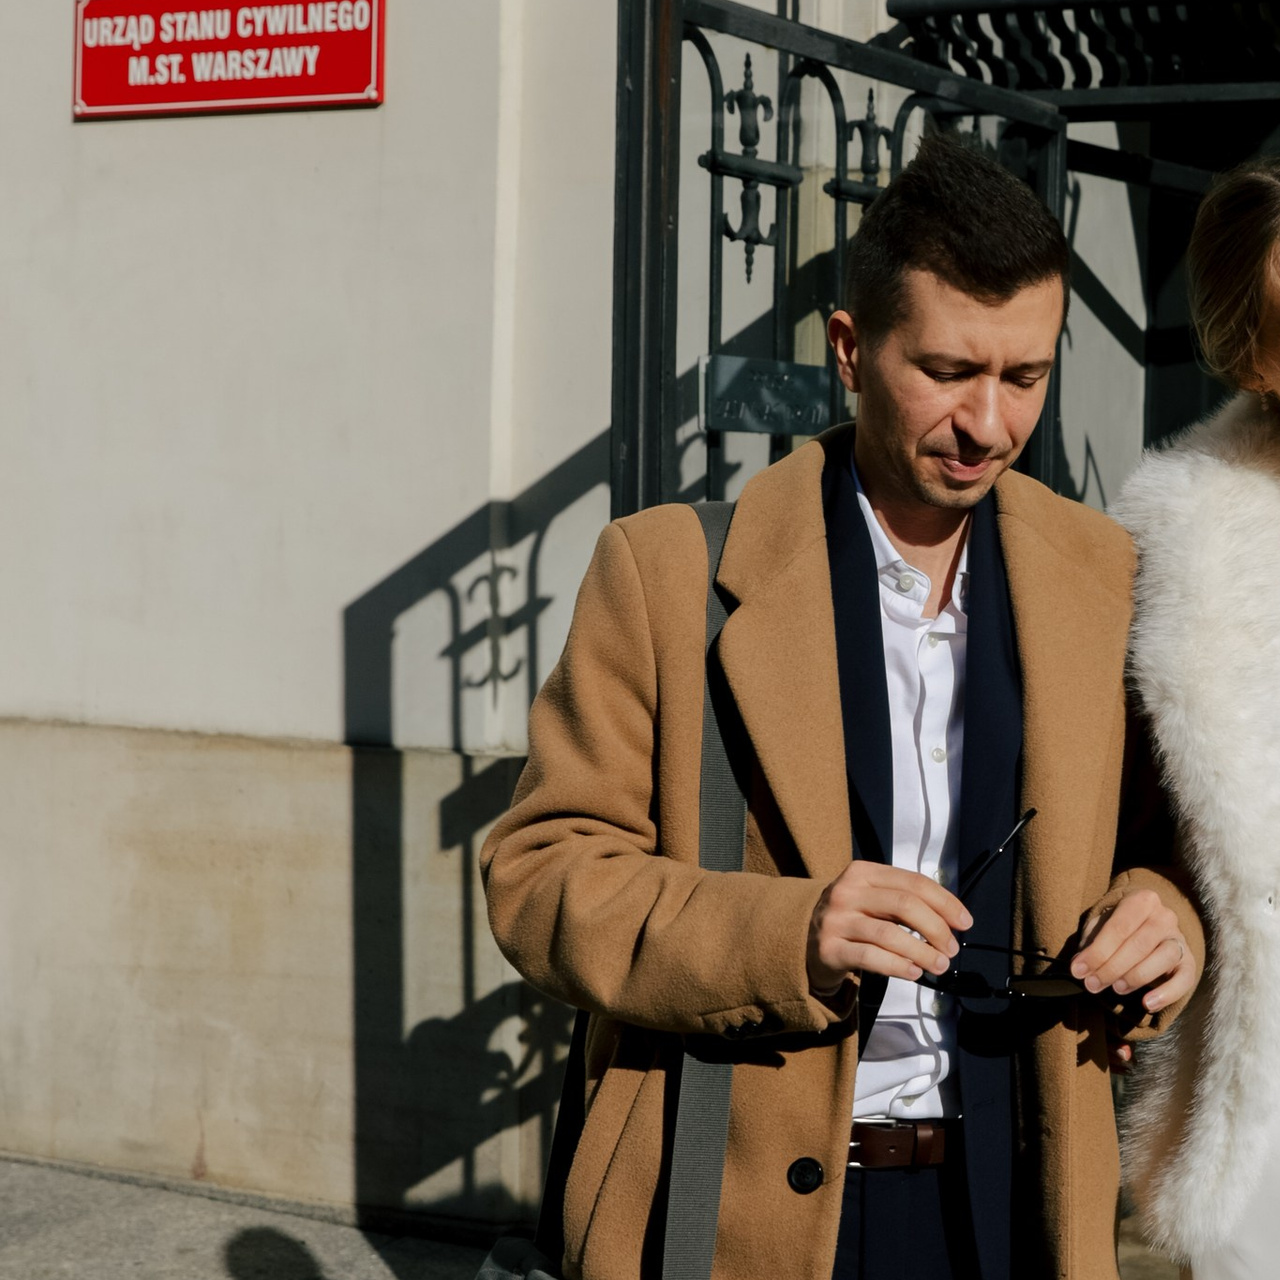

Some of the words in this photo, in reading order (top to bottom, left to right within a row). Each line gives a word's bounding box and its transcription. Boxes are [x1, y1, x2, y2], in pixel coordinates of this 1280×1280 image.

[84, 15, 155, 50] URZĄD
[160, 9, 231, 43] STANU
[237, 0, 370, 38] CYWILNEGO
[128, 54, 186, 85] M.ST.
[192, 45, 320, 82] WARSZAWY
